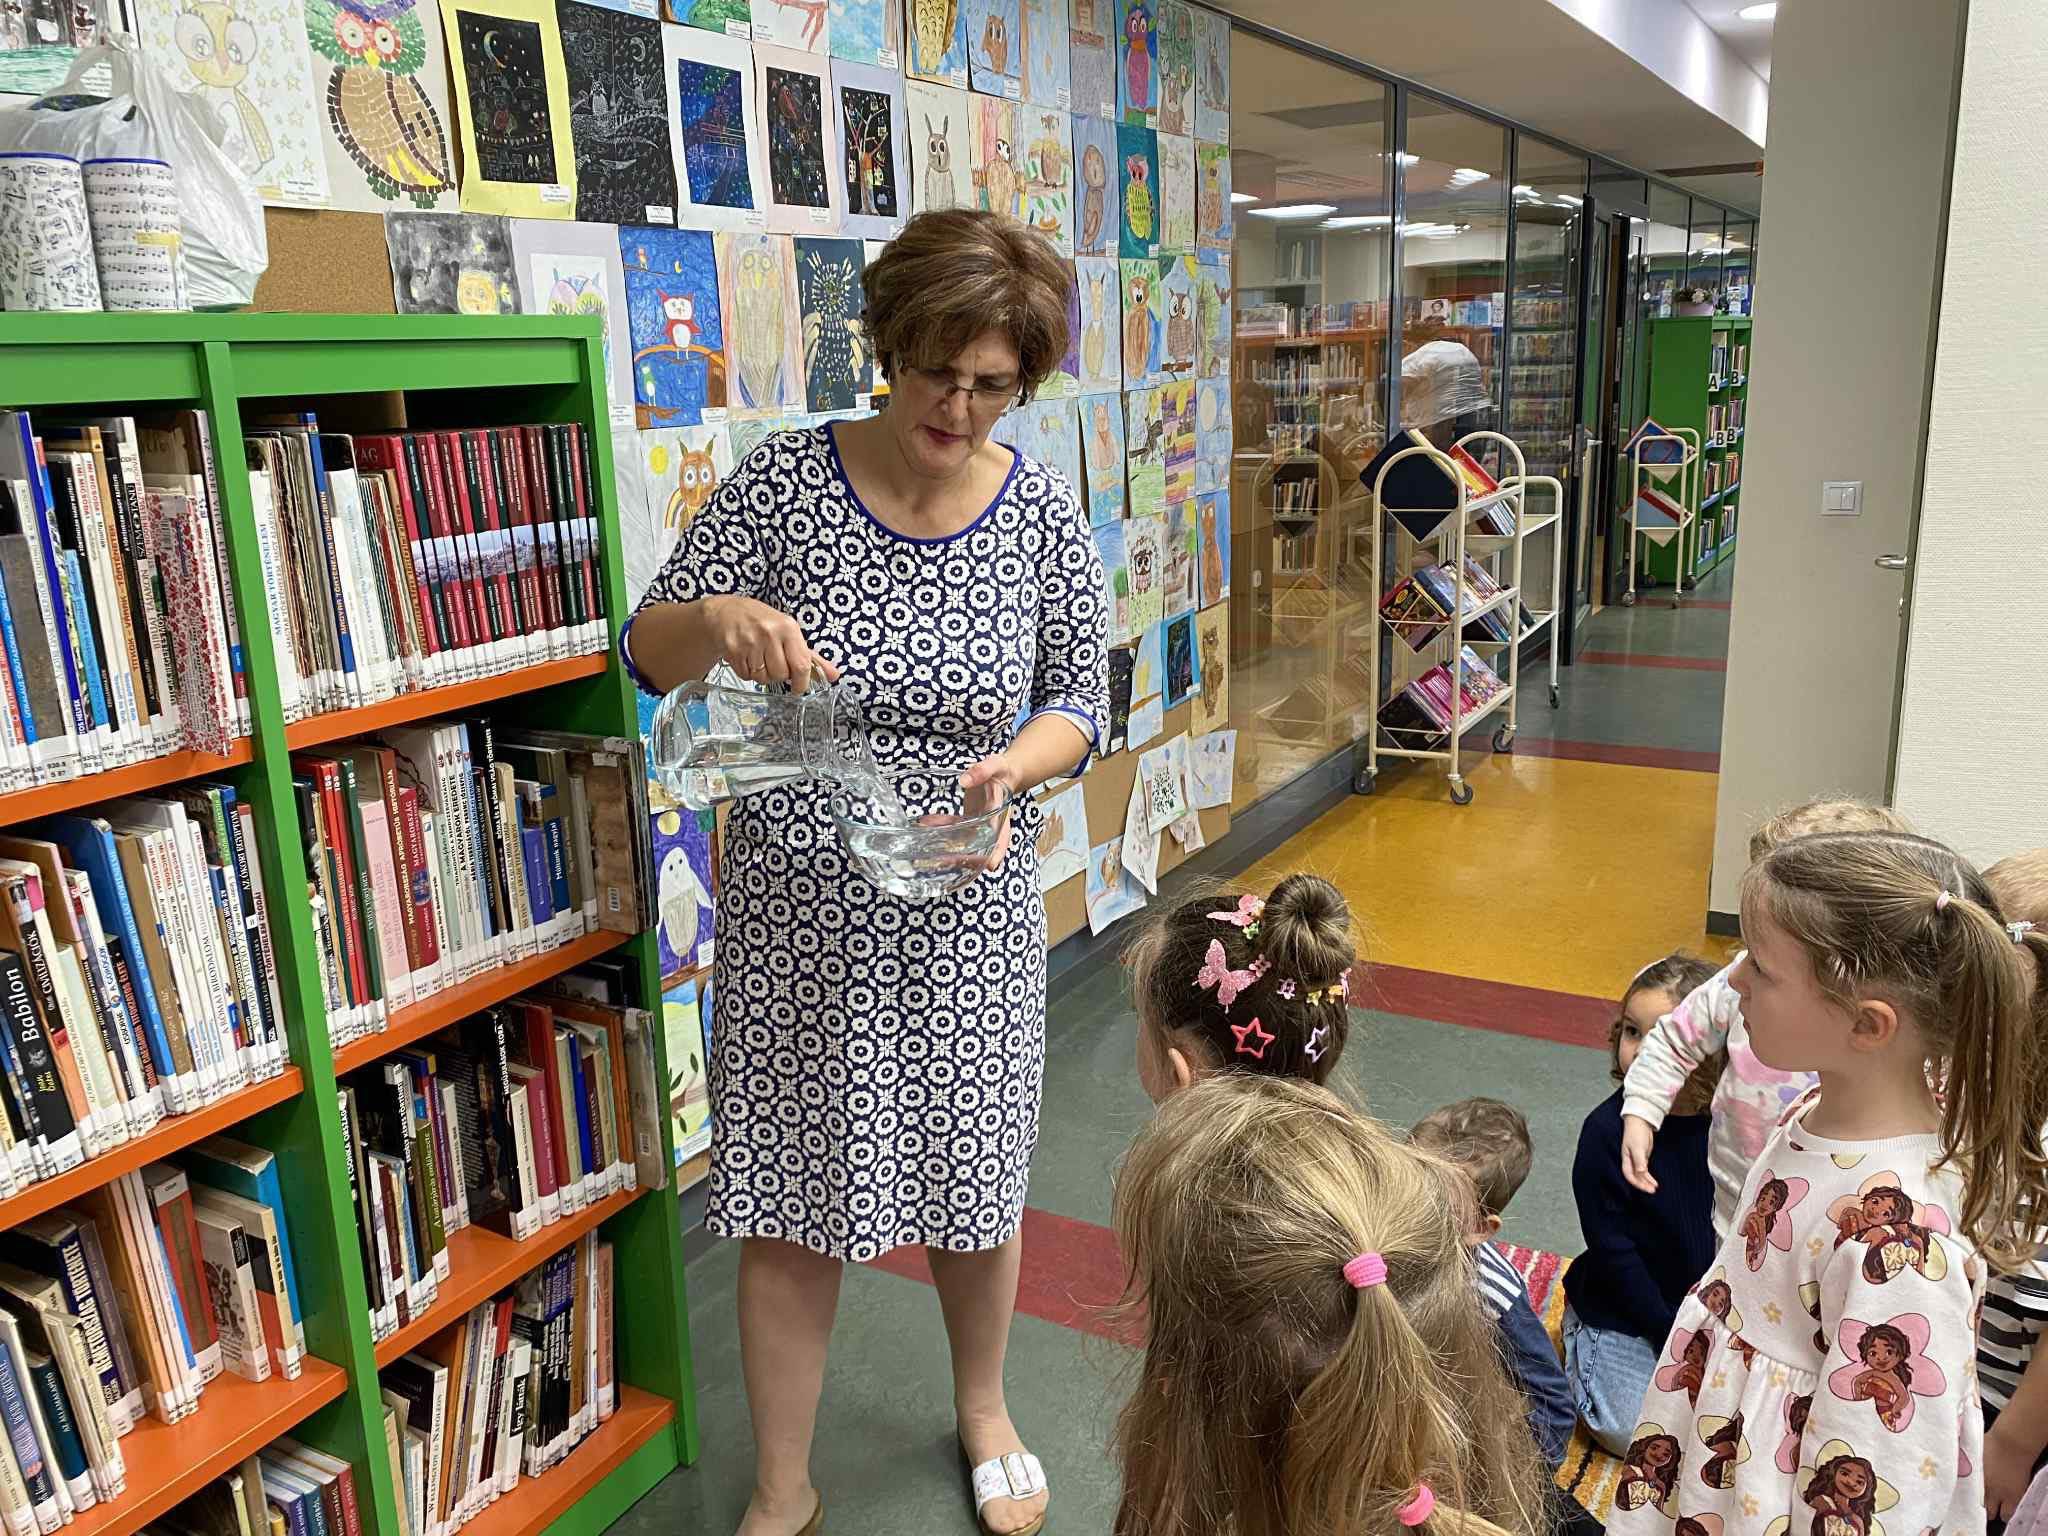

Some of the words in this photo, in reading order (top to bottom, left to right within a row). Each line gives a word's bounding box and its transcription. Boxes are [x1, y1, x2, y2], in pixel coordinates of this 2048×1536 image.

[1708, 375, 1717, 389] A
[1731, 371, 1738, 384] B
[1716, 432, 1724, 445] B
[1727, 429, 1734, 442] B
[348, 772, 356, 788] 100
[385, 768, 399, 814] HISTÓRIÁJA
[448, 774, 459, 812] EREDETE
[404, 799, 420, 866] MAGYARORSZÁG
[453, 813, 466, 863] MAGYAROK
[235, 852, 247, 878] ÓKORI
[240, 878, 250, 891] AZ
[399, 862, 414, 924] MAGYARORSZÁG
[252, 891, 264, 921] CSODÁI
[23, 929, 52, 995] CIVILIZÁCIÓK
[257, 921, 273, 974] TÖRTÉNELEM
[3, 965, 40, 1042] Babilon
[495, 1022, 505, 1044] KORA
[342, 1141, 356, 1173] CSONKA
